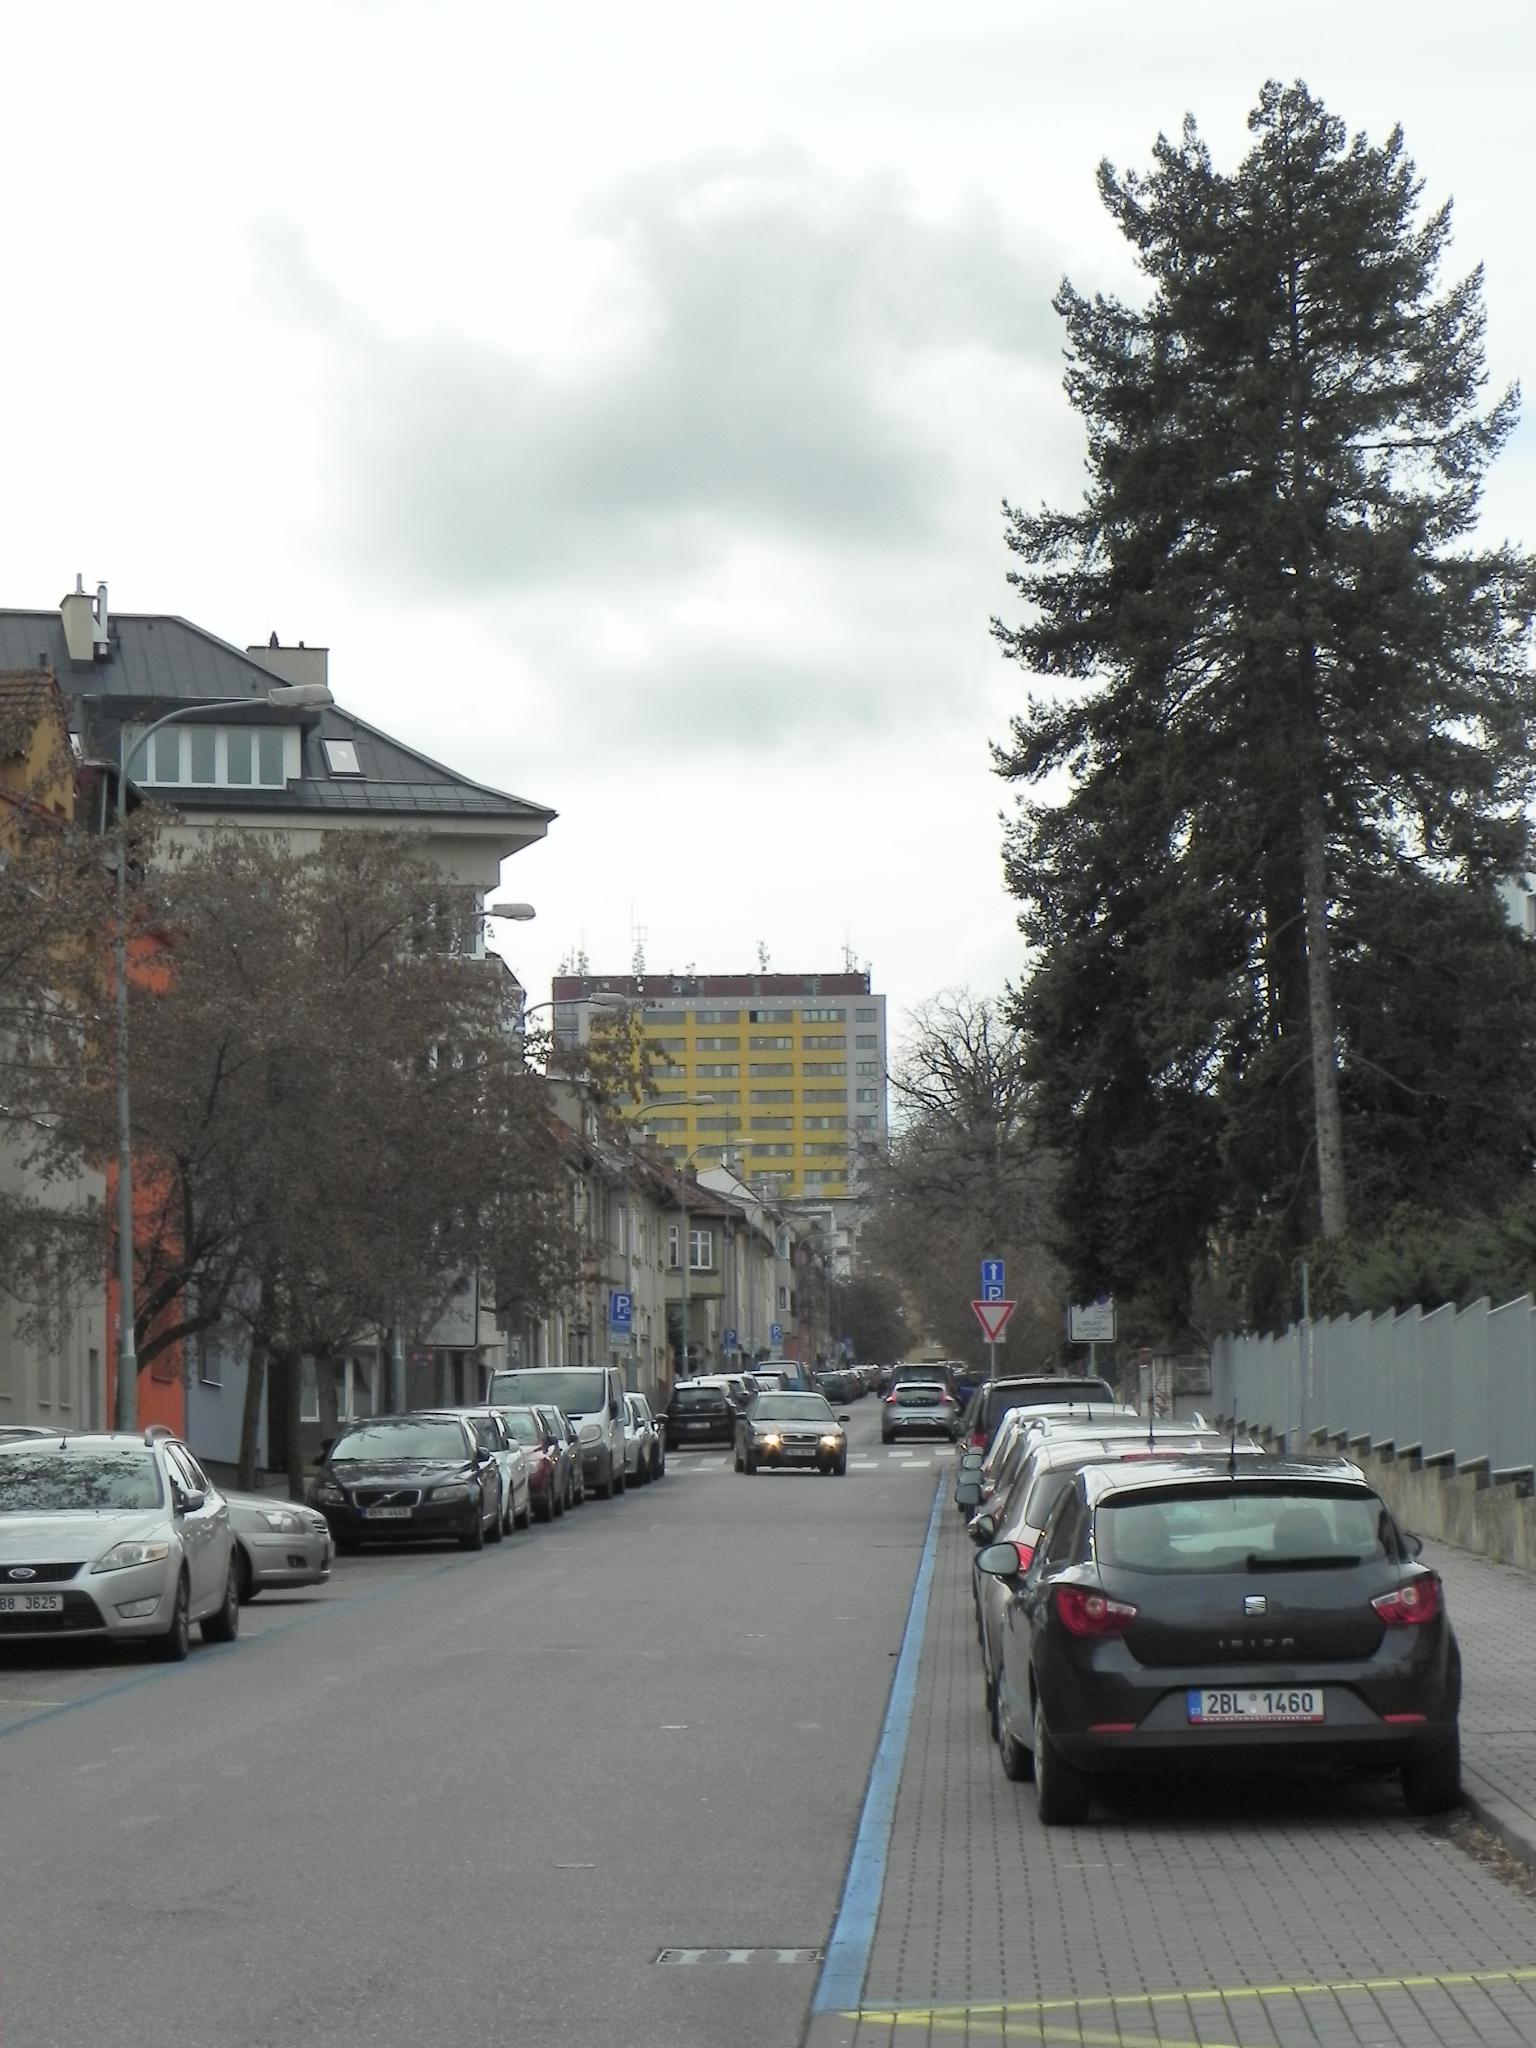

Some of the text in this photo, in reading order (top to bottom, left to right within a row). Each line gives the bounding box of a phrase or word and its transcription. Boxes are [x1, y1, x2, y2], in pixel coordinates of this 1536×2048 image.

[988, 1286, 1001, 1301] P
[617, 1295, 630, 1313] P
[25, 1596, 57, 1610] 3625
[1207, 1693, 1245, 1714] 2BL
[1263, 1692, 1313, 1713] 1460
